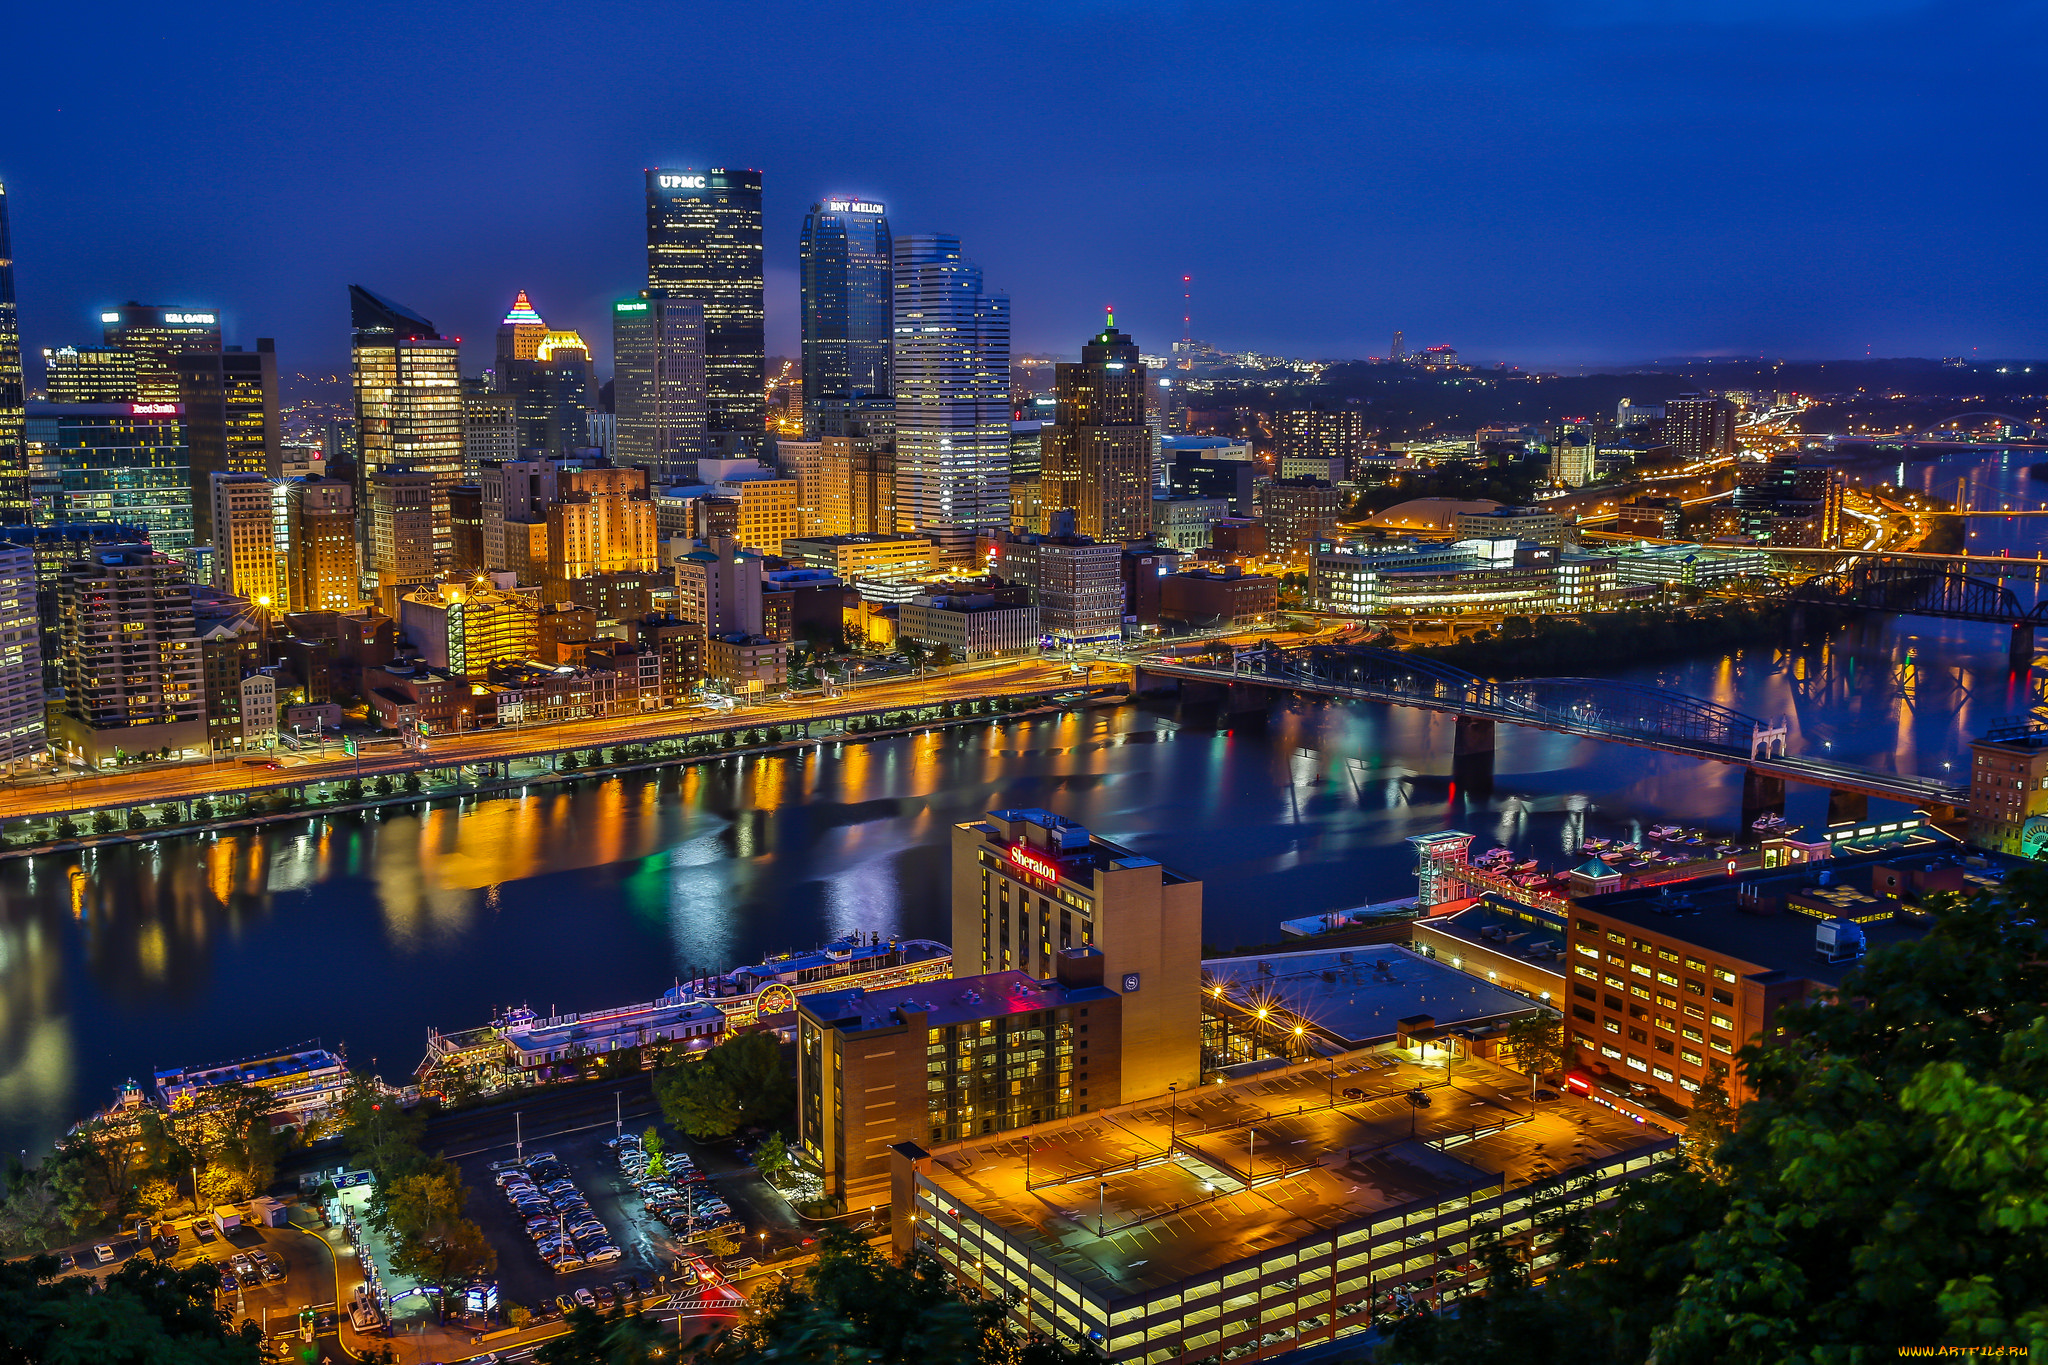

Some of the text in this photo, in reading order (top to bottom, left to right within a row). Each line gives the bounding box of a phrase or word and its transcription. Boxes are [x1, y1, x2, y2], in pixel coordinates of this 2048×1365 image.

[659, 175, 706, 188] UPMC
[830, 201, 883, 214] BNY MELLON
[184, 313, 215, 324] GATES
[132, 404, 176, 413] Reed Smith
[1011, 846, 1056, 881] Sheraton
